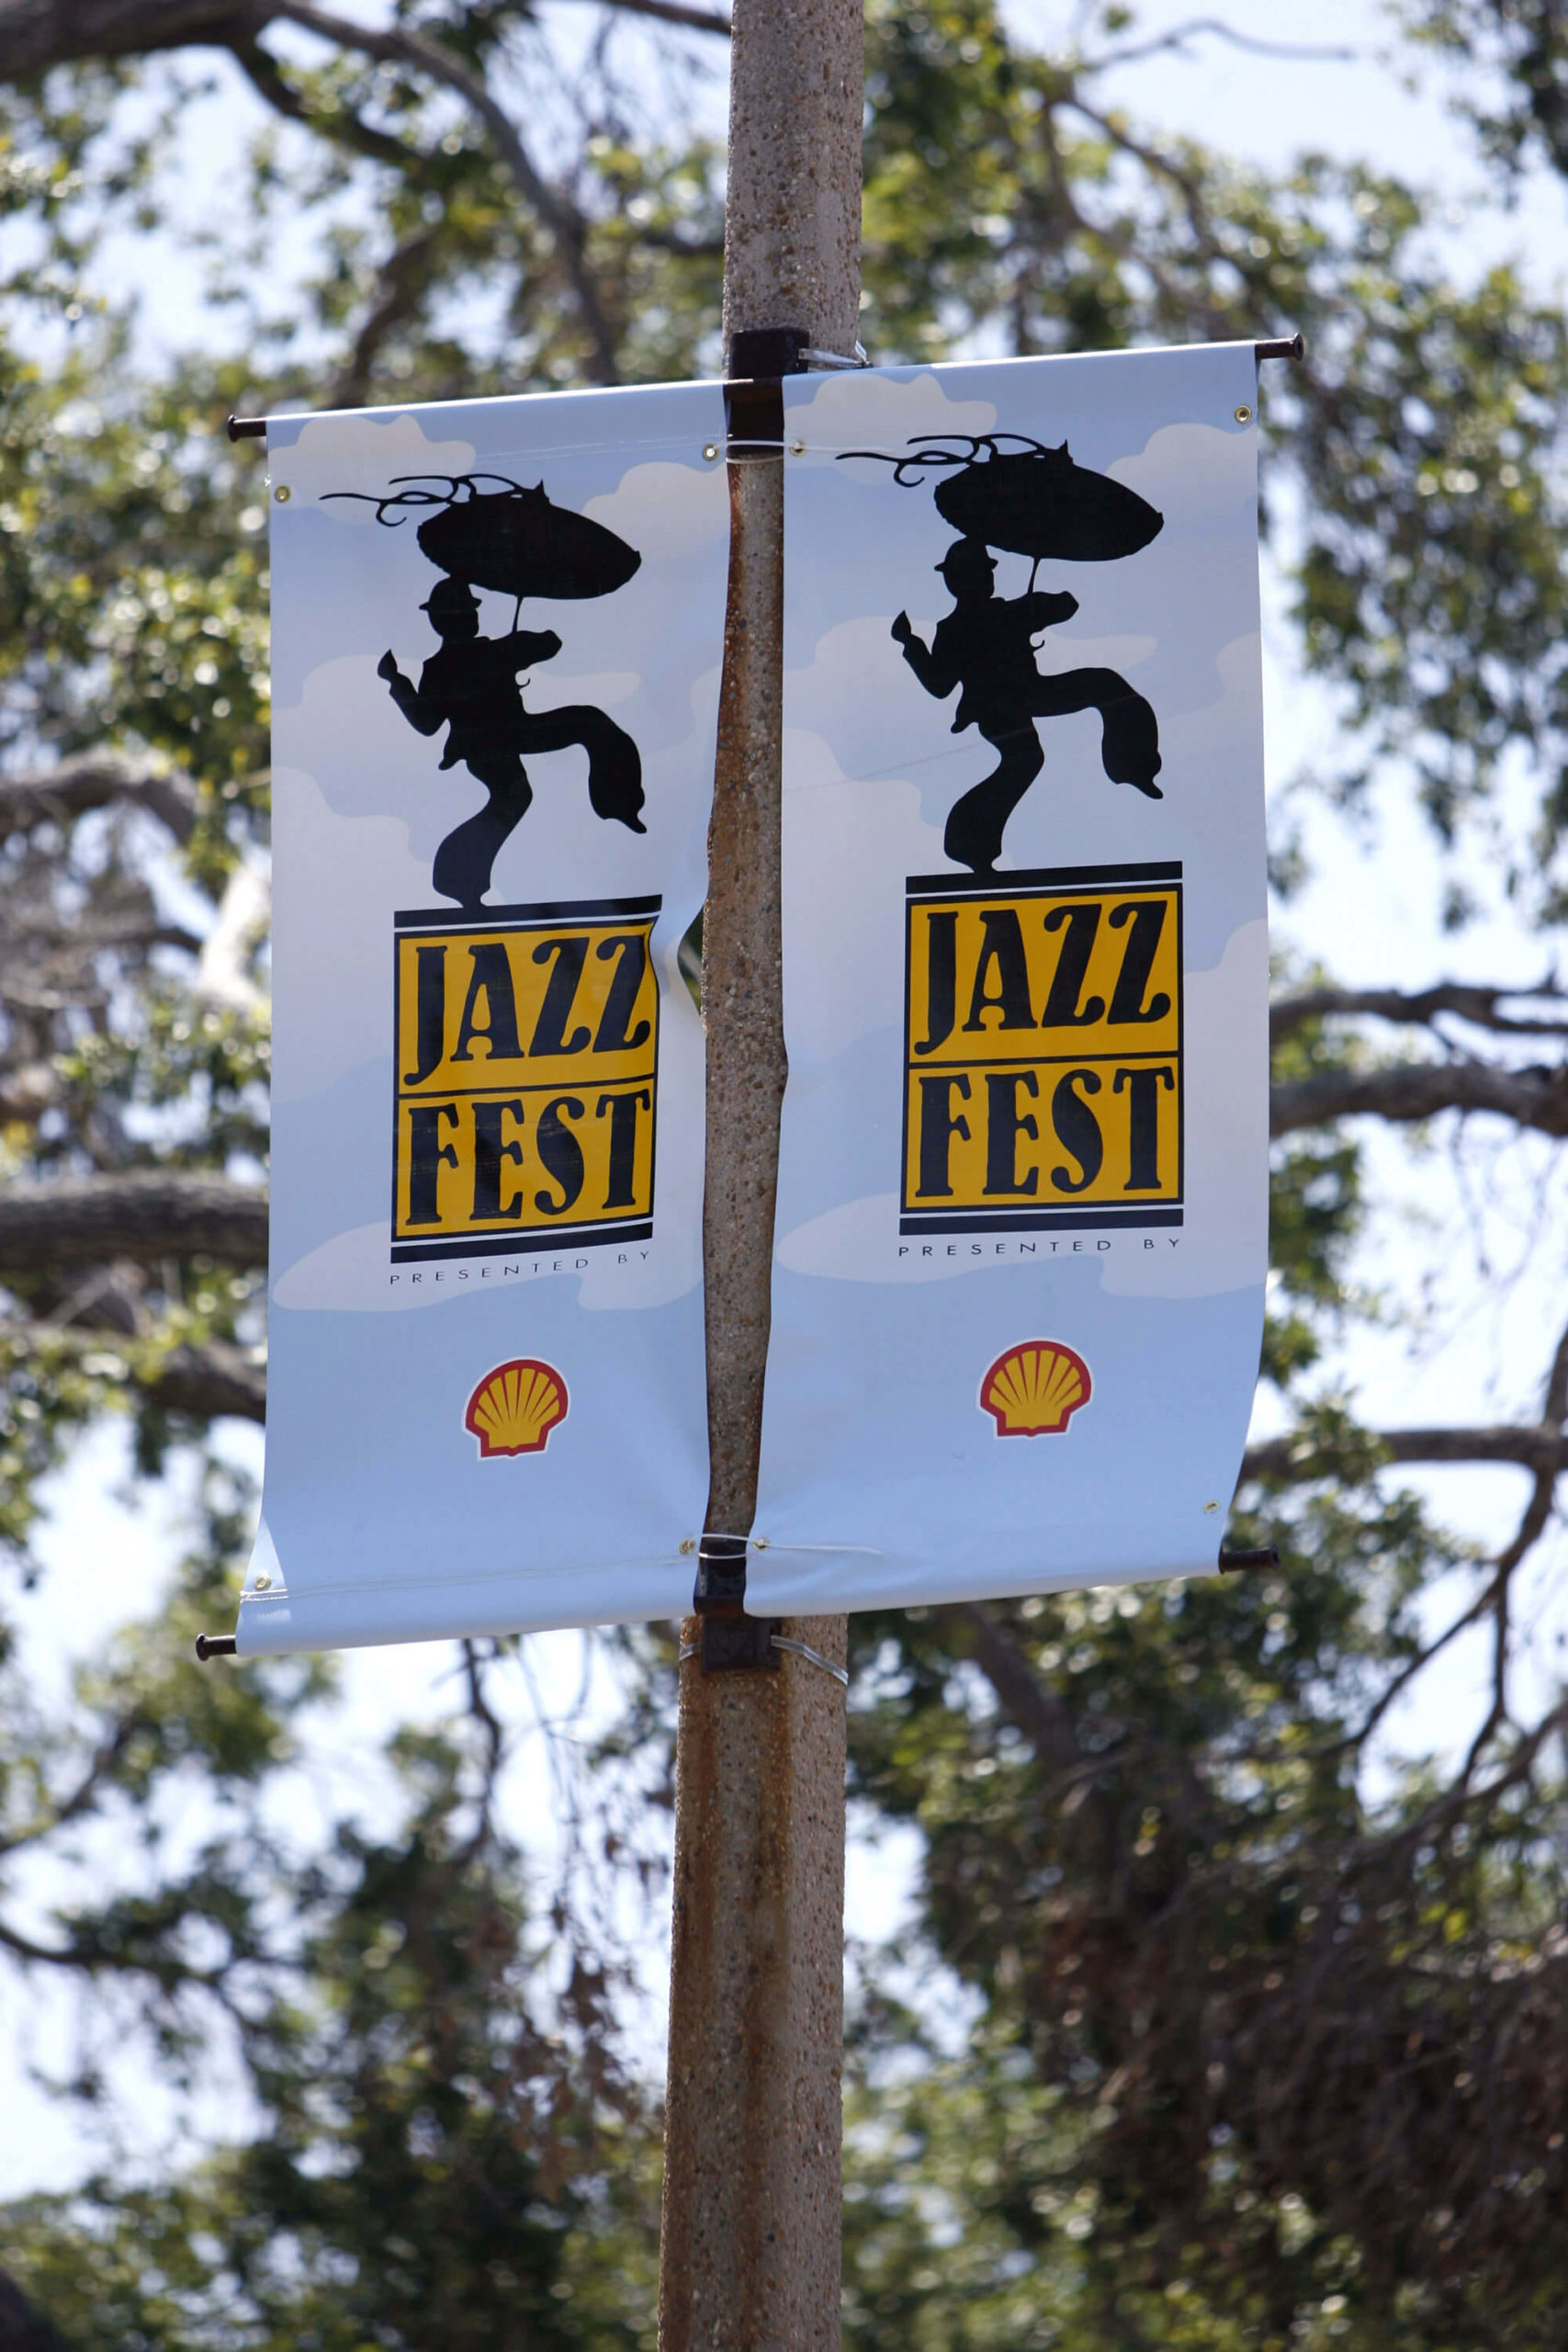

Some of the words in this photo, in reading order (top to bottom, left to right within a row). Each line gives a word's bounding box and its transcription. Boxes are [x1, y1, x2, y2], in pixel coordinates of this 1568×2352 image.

[404, 934, 650, 1086] JAZZ
[914, 899, 1171, 1056] JAZZ
[405, 1089, 651, 1226] FEST
[915, 1066, 1175, 1198] FEST
[389, 1257, 589, 1285] PRESENTED
[617, 1250, 650, 1264] BY
[898, 1239, 1111, 1258] PRESENTED
[1144, 1238, 1180, 1250] BY
